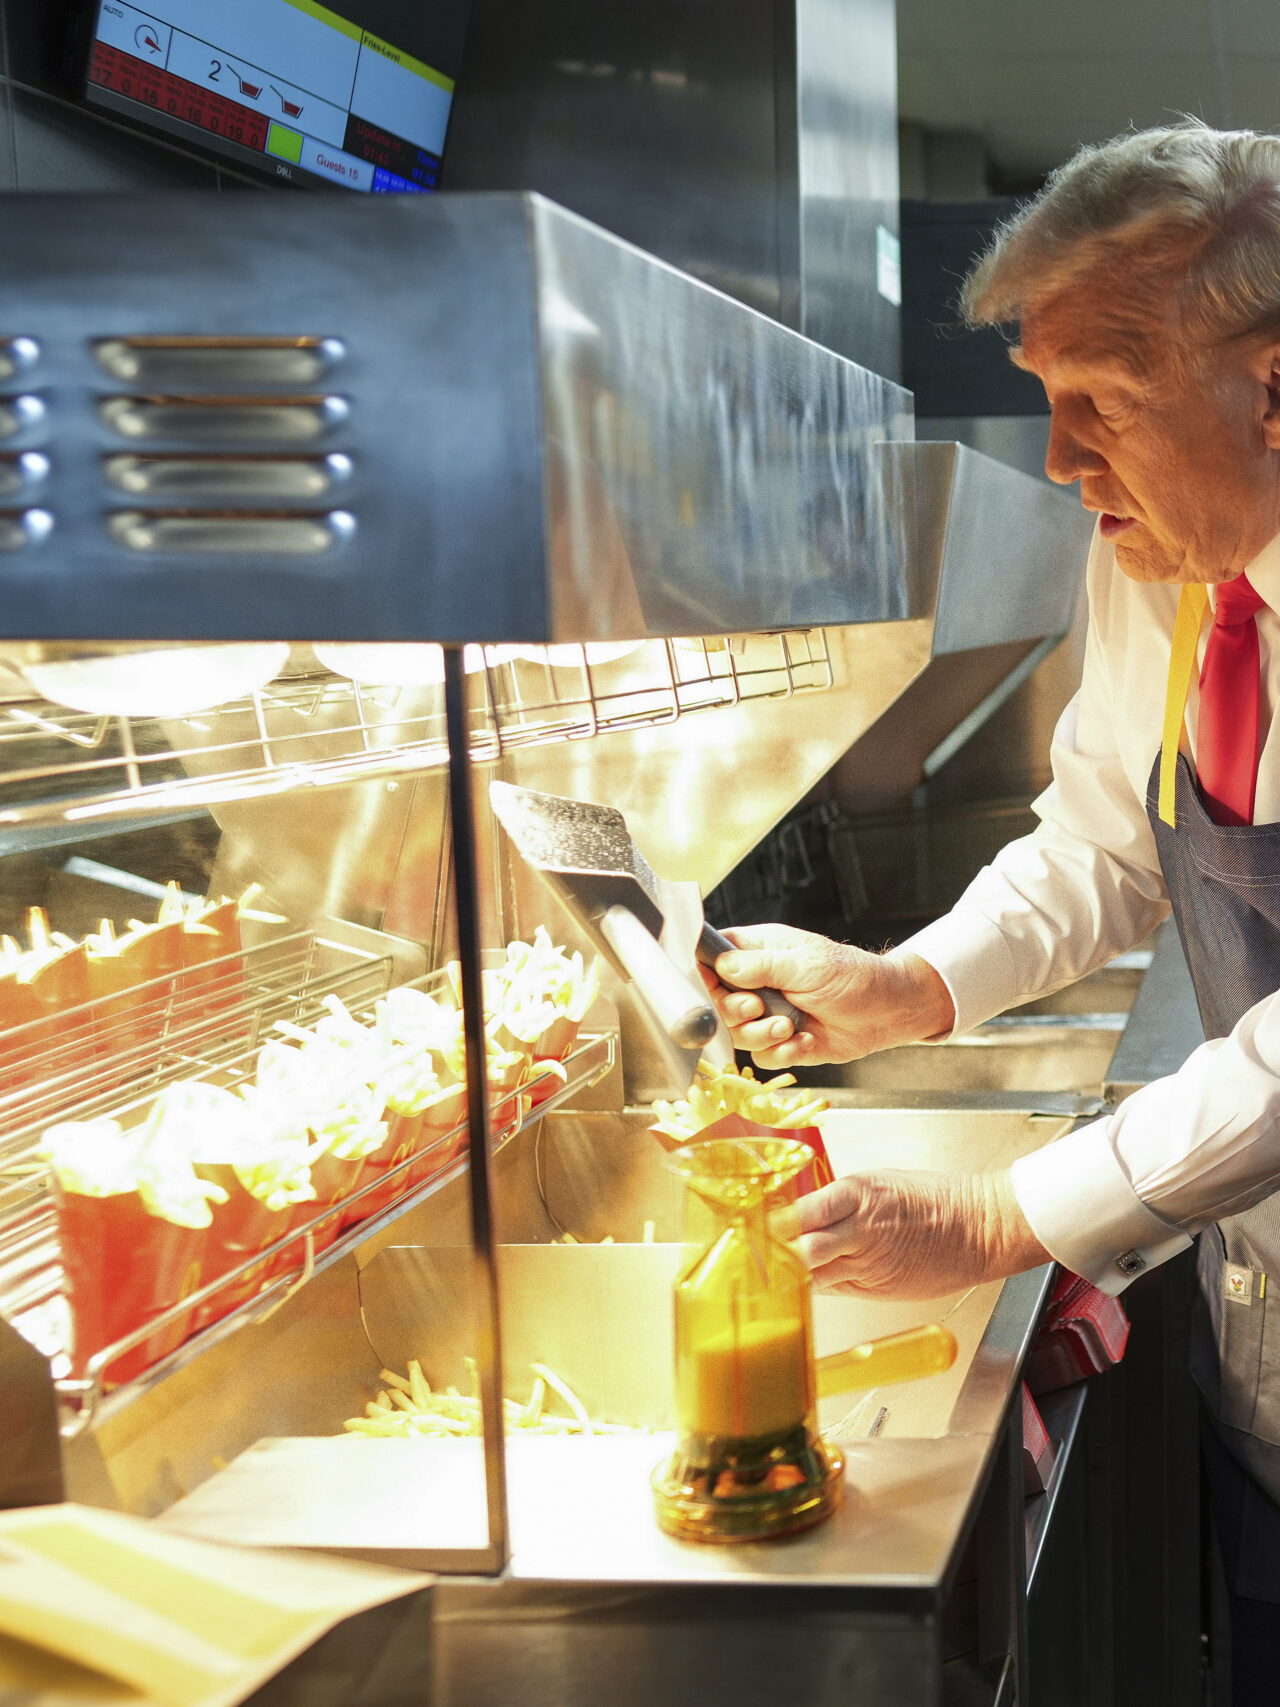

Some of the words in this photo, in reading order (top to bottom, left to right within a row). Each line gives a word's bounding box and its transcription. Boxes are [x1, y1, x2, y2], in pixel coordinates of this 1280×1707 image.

[103, 4, 124, 18] AUTO
[208, 60, 221, 82] 2
[229, 124, 243, 140] 19
[316, 153, 346, 175] Guests
